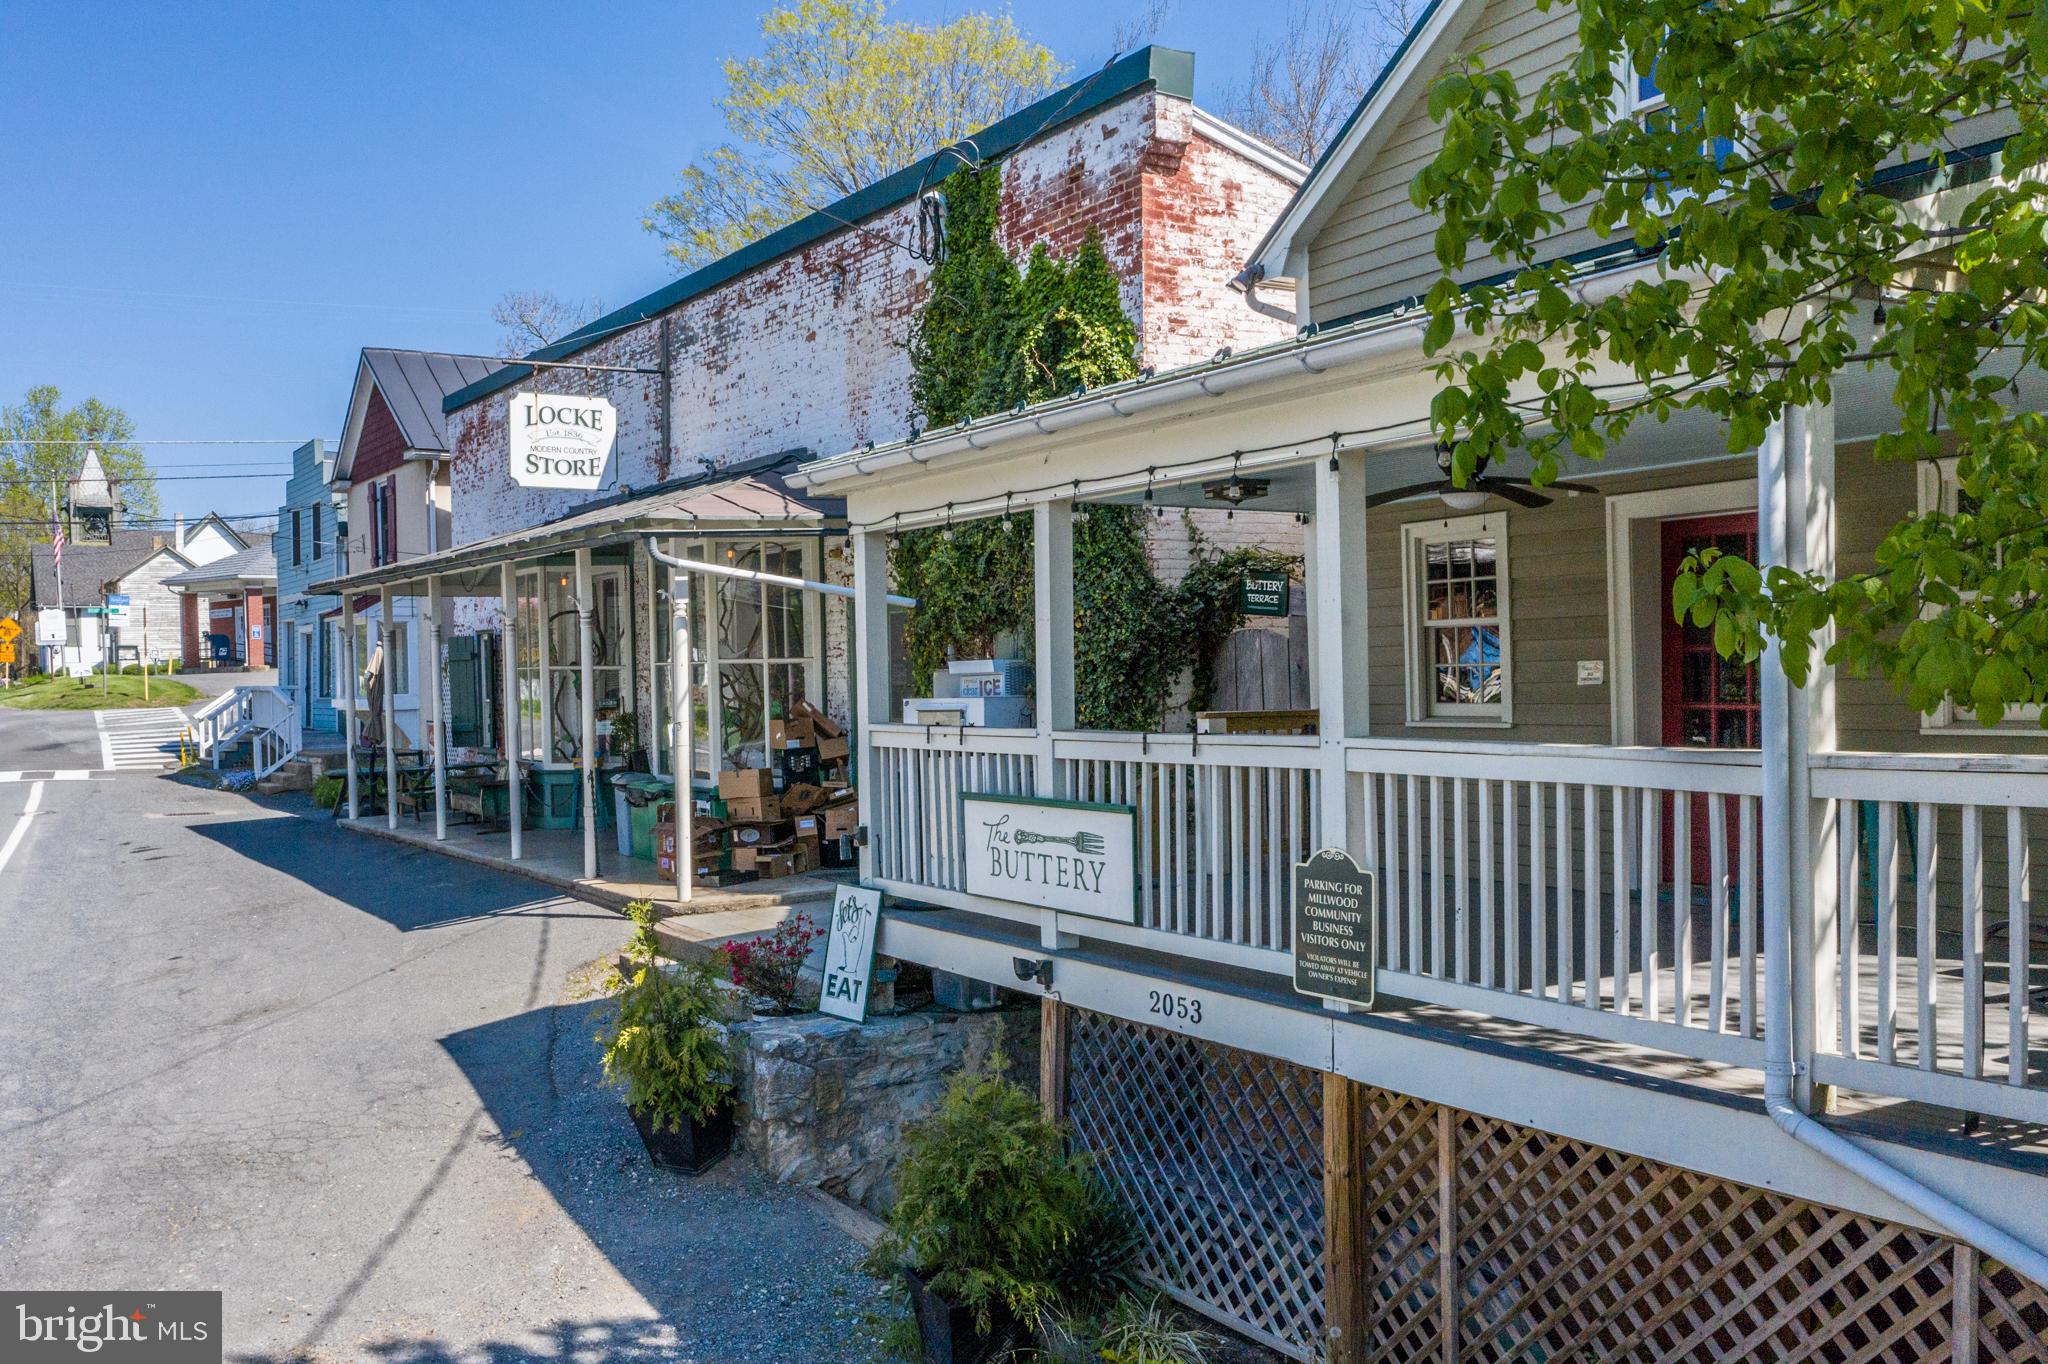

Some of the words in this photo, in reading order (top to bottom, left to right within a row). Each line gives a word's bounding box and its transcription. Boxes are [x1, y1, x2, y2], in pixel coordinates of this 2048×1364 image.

[525, 405, 602, 431] LOCKE
[530, 446, 562, 454] MODERN
[563, 447, 599, 456] COUNTRY
[526, 454, 601, 477] STORE
[1246, 579, 1285, 592] BUTTERY
[1247, 593, 1279, 604] TERRACE
[979, 678, 1002, 697] ICE
[983, 814, 1011, 851] The
[990, 846, 1106, 894] BUTTERY
[1304, 878, 1342, 893] PARKING
[1344, 883, 1363, 896] FOR
[1307, 892, 1358, 909] MILLWOOD
[1304, 905, 1362, 924] COMMUNITY
[1312, 920, 1354, 937] BUSINESS
[1301, 932, 1339, 949] VISITORS
[1341, 938, 1366, 953] ONLY
[1299, 959, 1319, 970] TOWED
[1320, 962, 1336, 973] AWAY
[1336, 965, 1344, 975] AT
[1344, 967, 1368, 979] VEHICLE
[1306, 952, 1337, 965] VIOLATORS
[1338, 958, 1351, 968] WILL
[1352, 961, 1360, 969] BE
[826, 973, 863, 1002] EAT
[1308, 970, 1333, 981] OWNER'S
[1334, 975, 1358, 986] EXPENSE
[1149, 990, 1202, 1024] 2053
